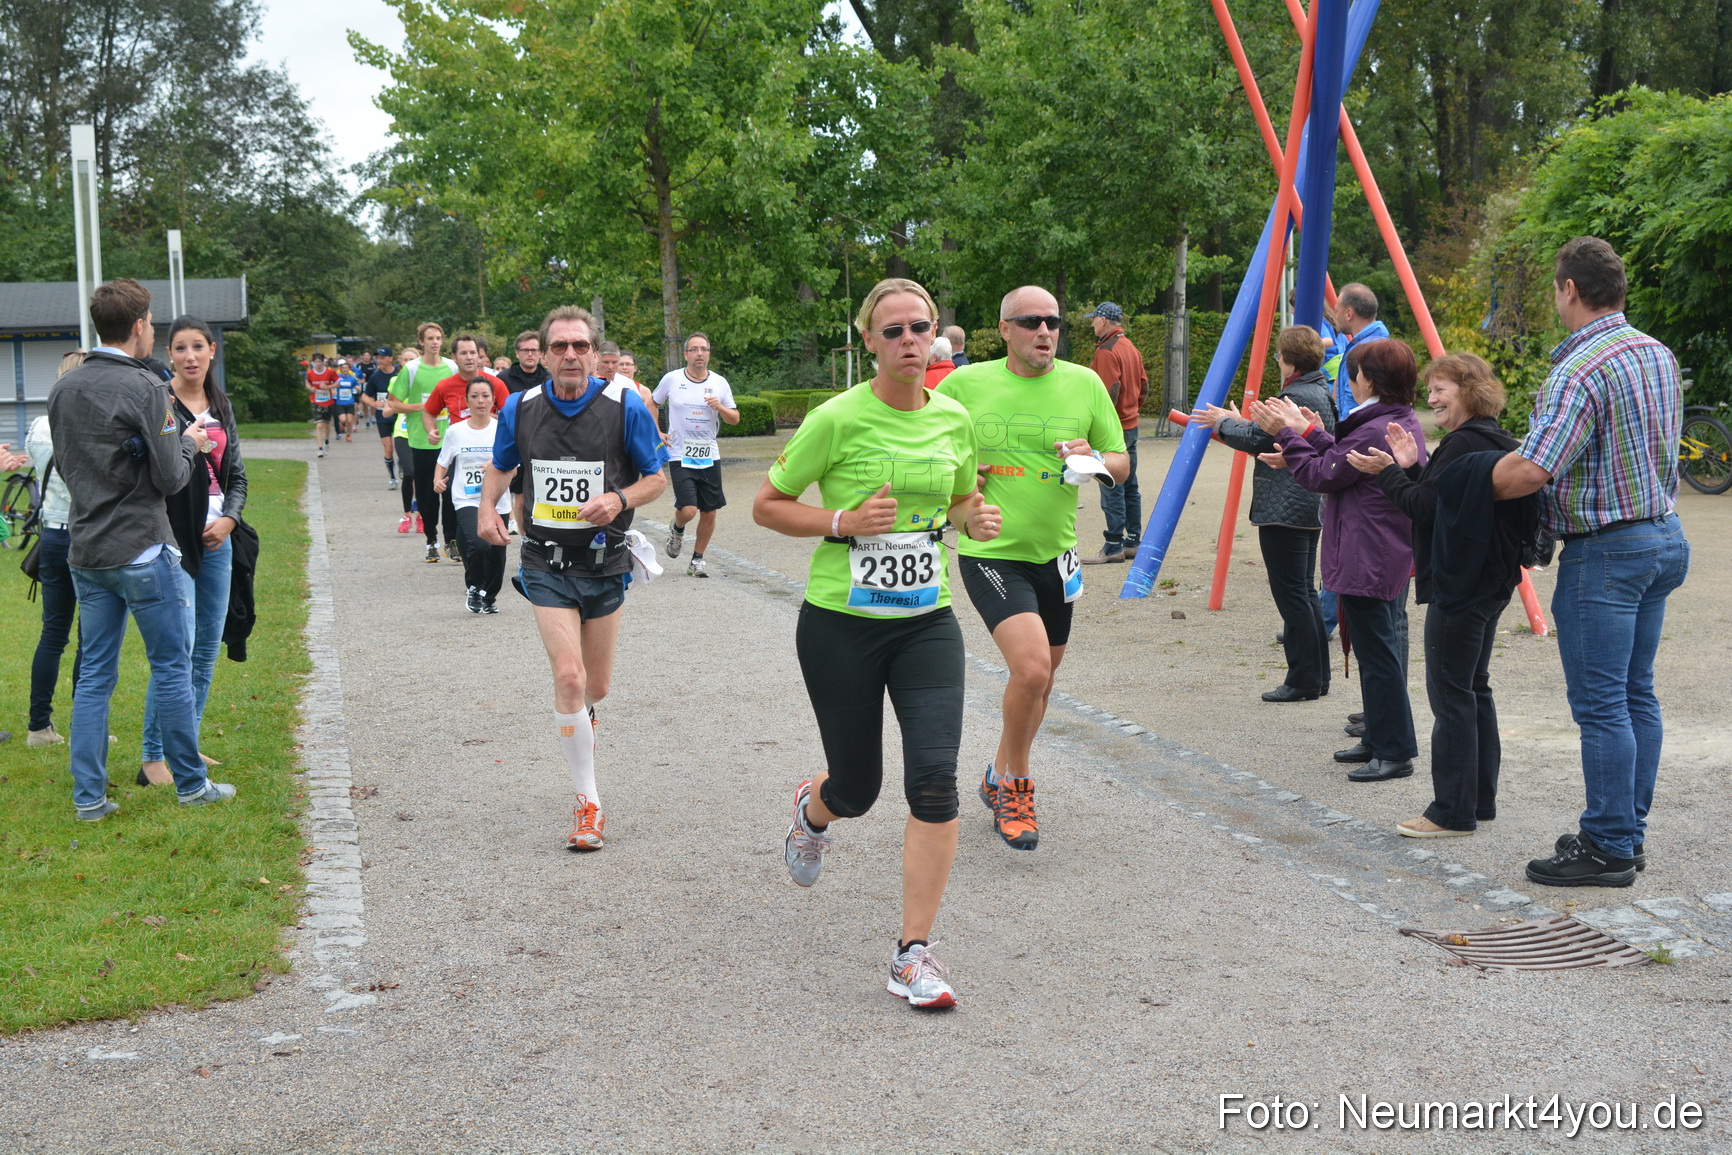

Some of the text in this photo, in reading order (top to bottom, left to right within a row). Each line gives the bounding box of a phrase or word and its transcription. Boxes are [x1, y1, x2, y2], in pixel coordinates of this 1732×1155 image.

[686, 446, 711, 458] 2260
[533, 465, 592, 475] PARTL Neumarkt
[987, 465, 1026, 477] MERZ
[545, 477, 590, 503] 258
[551, 508, 579, 519] Lotha
[852, 541, 926, 552] PARTL Neumarkt
[860, 552, 934, 588] 2383
[870, 592, 920, 606] Theresia
